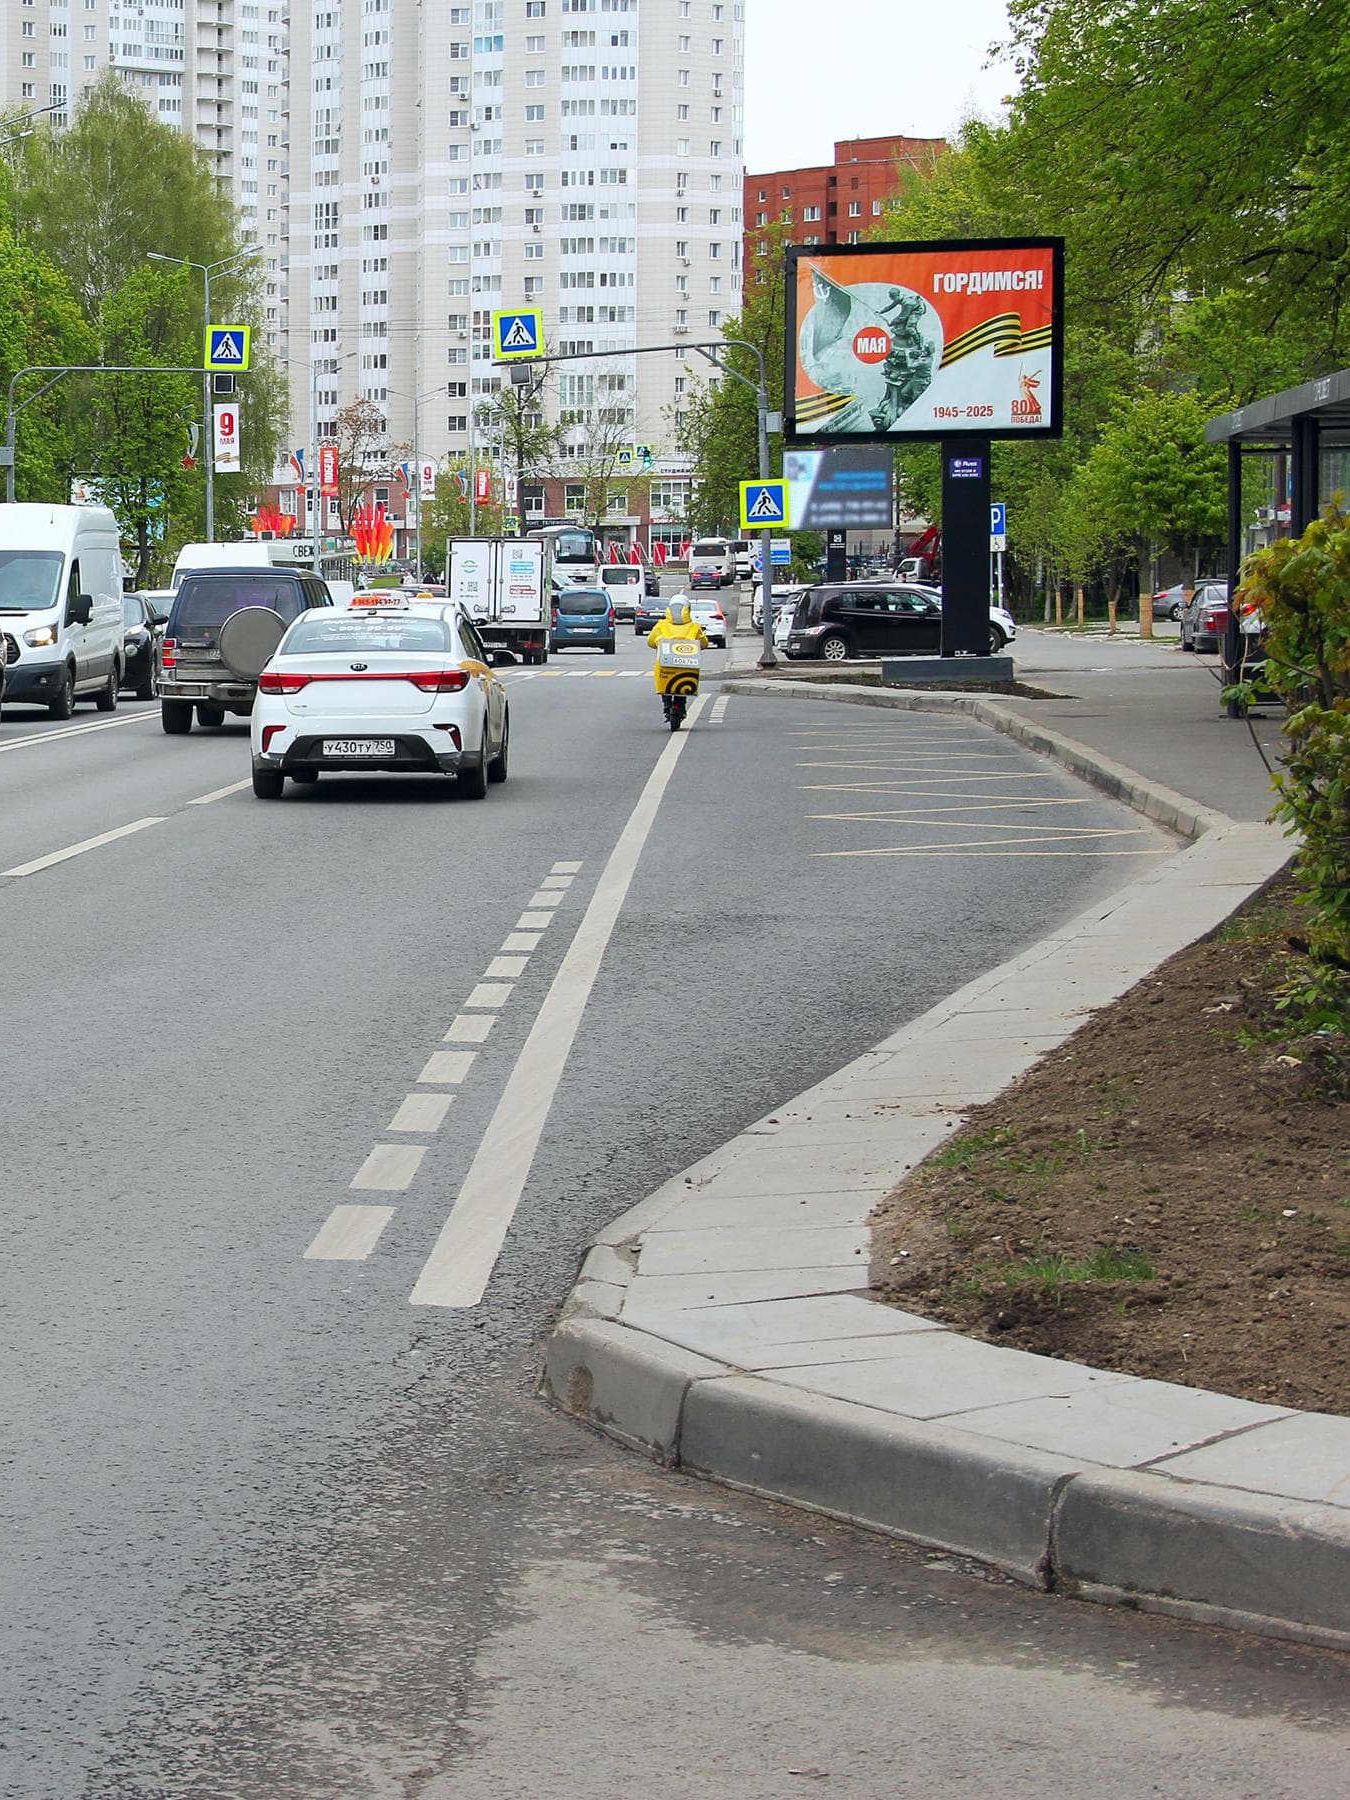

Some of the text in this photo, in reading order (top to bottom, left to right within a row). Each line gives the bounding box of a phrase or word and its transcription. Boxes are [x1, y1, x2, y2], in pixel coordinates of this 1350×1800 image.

[933, 270, 1043, 295] ГОРДИМСЯ!
[857, 337, 886, 353] МАЯ
[1011, 400, 1028, 414] 80
[219, 412, 234, 436] 9
[1011, 415, 1042, 424] ПОБЕДА!
[219, 437, 235, 445] МАЯ
[423, 466, 432, 480] 9
[991, 507, 1001, 533] P
